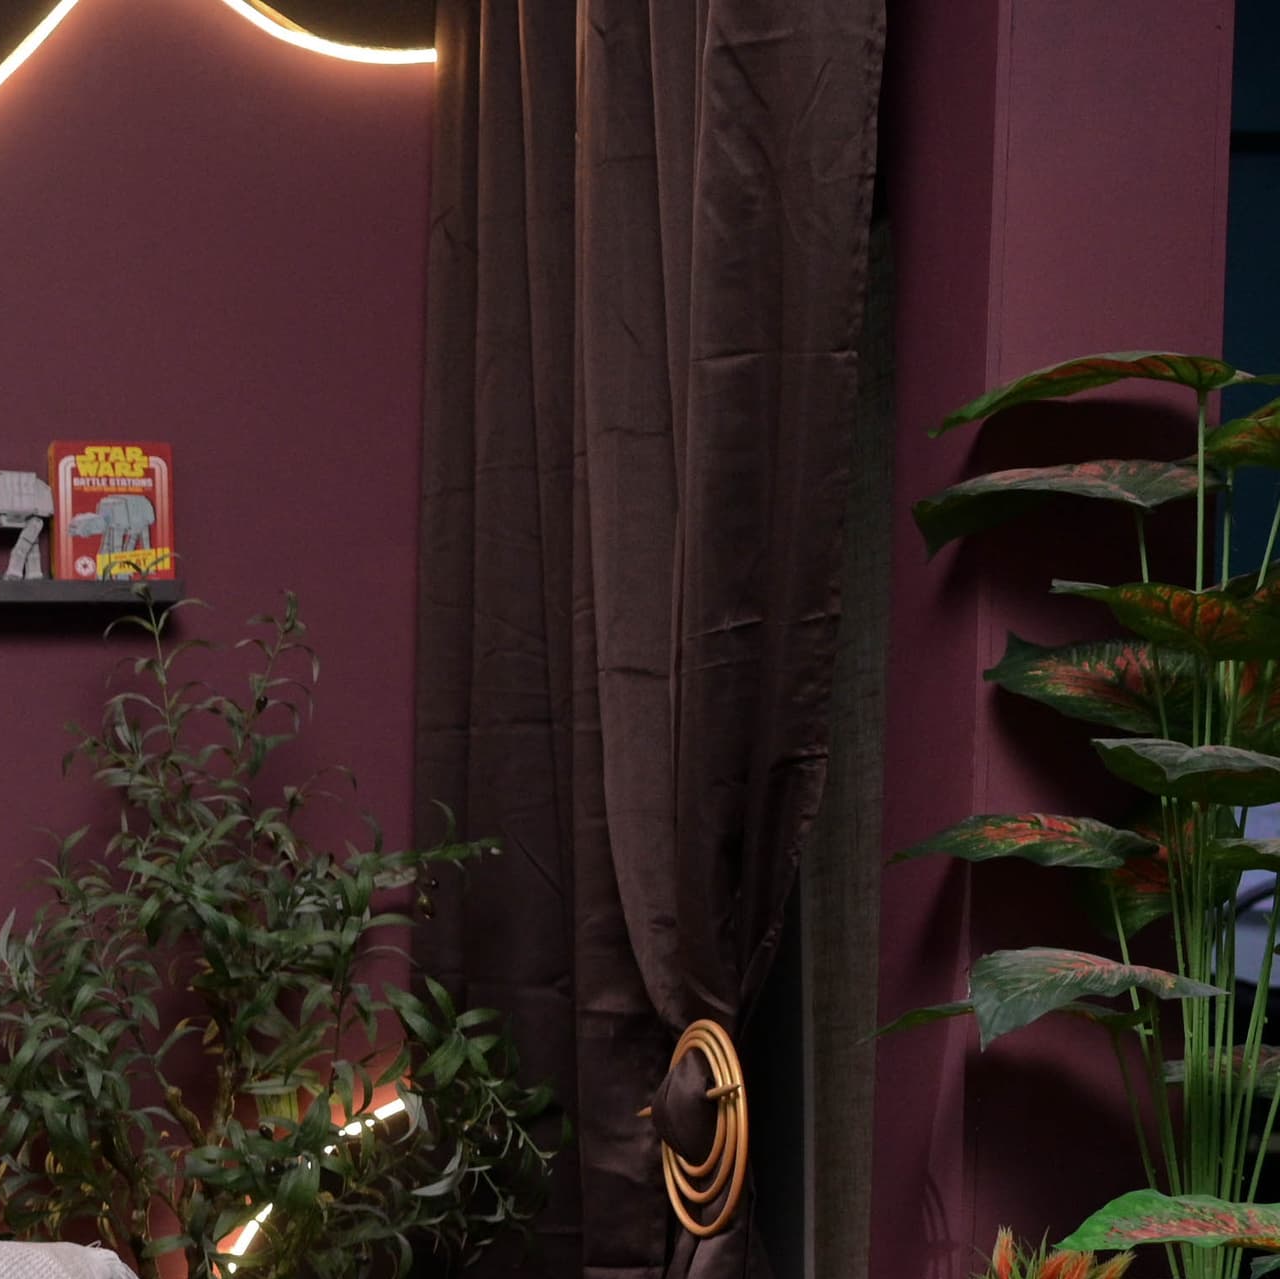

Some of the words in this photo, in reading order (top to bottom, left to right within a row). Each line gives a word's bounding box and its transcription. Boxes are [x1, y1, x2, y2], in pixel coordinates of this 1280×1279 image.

[76, 446, 143, 463] STAR
[77, 456, 149, 478] WARS
[73, 477, 109, 488] BATTLE
[110, 477, 153, 488] STATIONS
